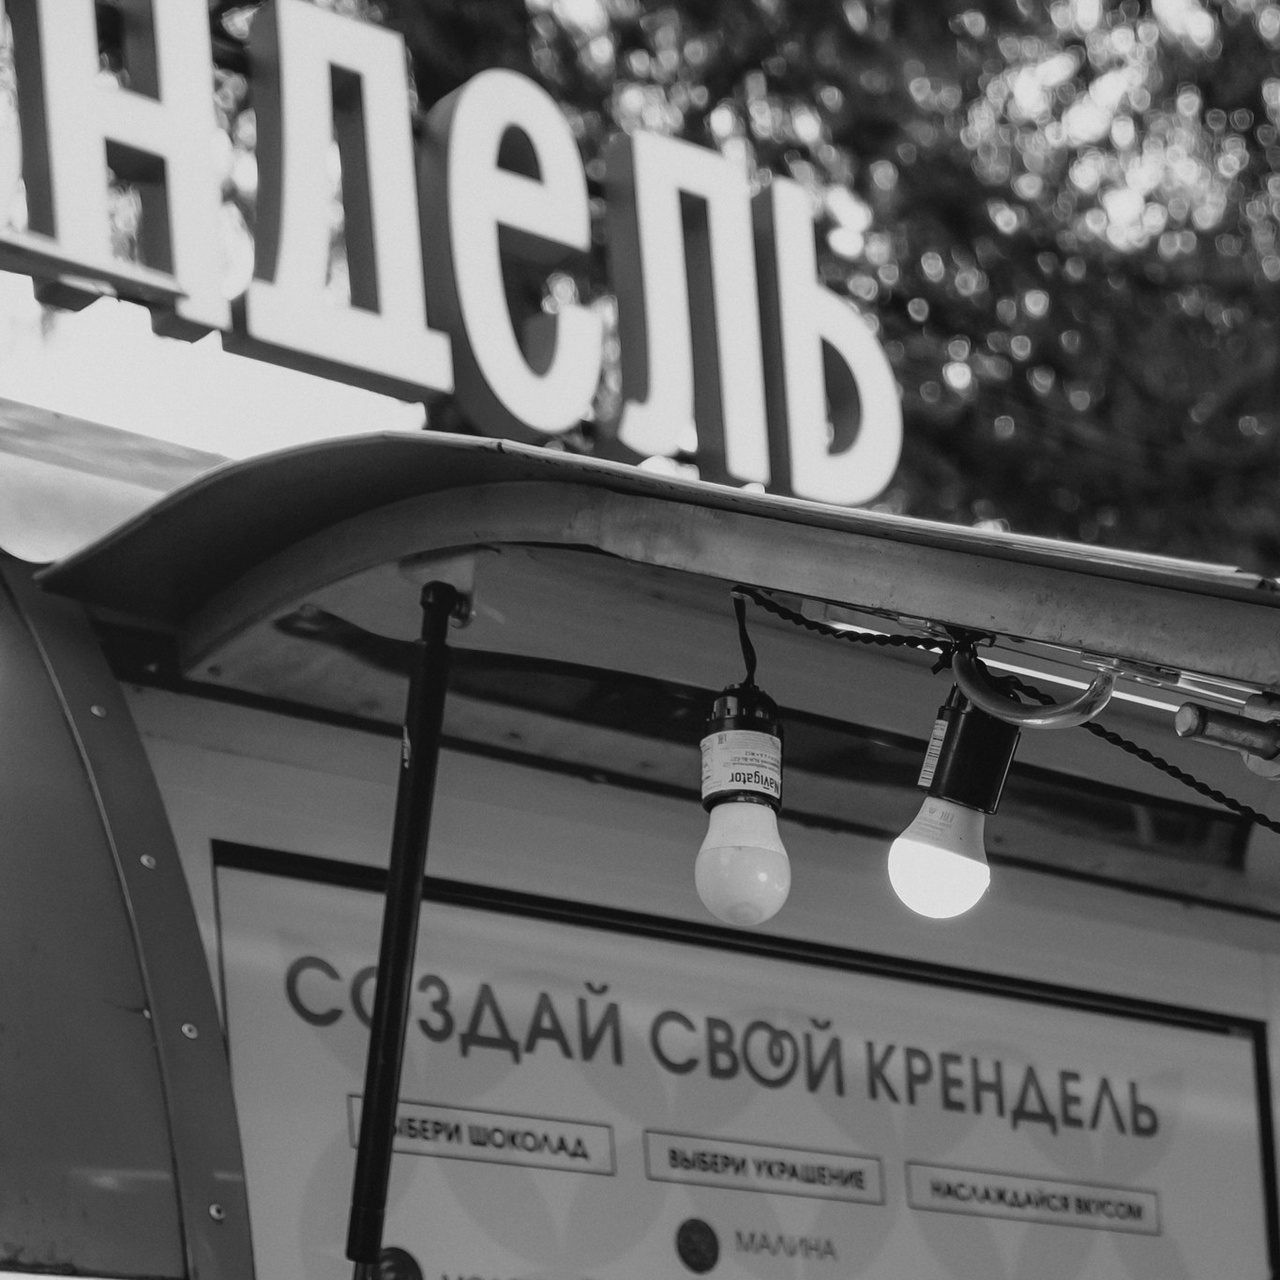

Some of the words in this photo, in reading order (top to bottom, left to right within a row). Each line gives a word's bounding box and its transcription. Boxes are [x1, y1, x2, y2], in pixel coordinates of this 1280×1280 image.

[728, 771, 780, 796] Navigator
[650, 1010, 845, 1097] СВОЙ
[865, 1040, 1160, 1138] КРЕНДЕЛЬ
[393, 1117, 462, 1143] БЕРИ
[467, 1124, 590, 1160] ШОКОЛАД
[668, 1148, 748, 1177] ВЫБЕРИ
[753, 1158, 866, 1191] УКРАШЕНИЕ
[930, 1178, 1070, 1213] НАСЛАЖДАЙСЯ
[1074, 1195, 1144, 1222] ВКУСОМ
[735, 1229, 838, 1261] МАЛИНА
